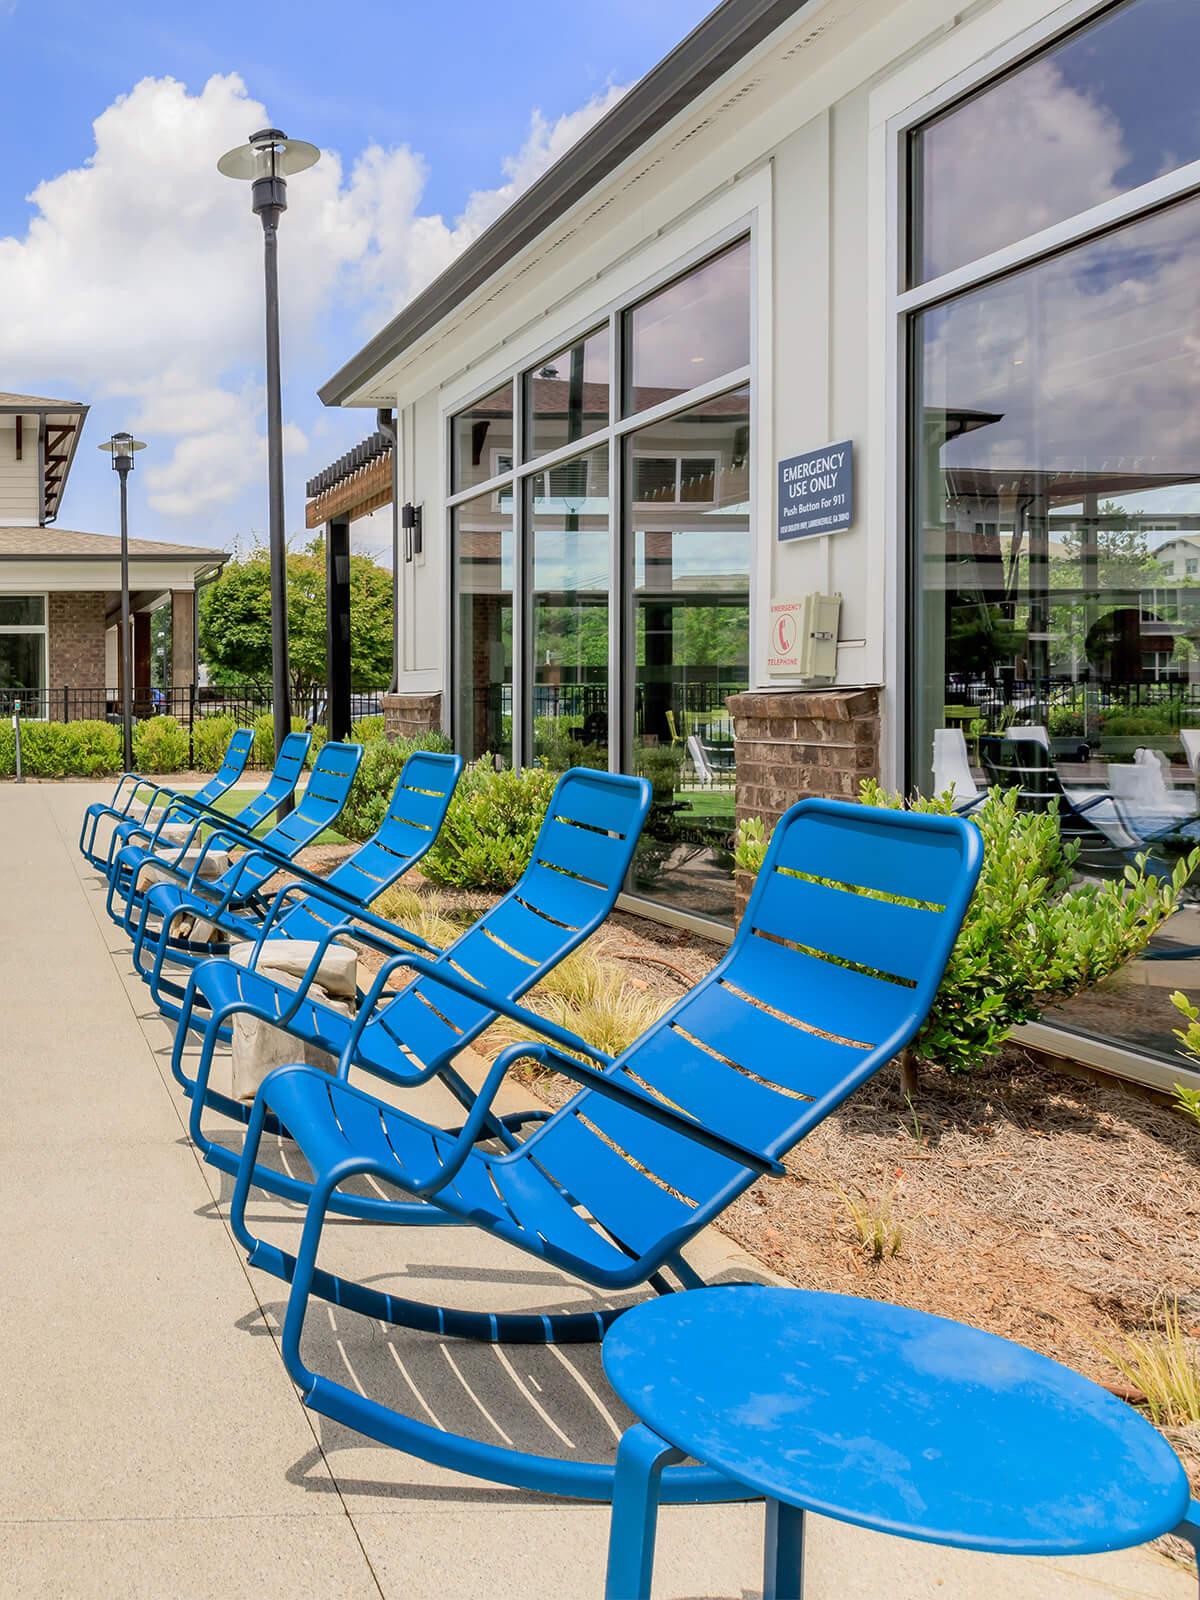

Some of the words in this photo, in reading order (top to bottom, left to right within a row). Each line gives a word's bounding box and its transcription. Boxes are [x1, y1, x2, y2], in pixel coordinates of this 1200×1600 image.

[783, 452, 845, 483] EMERGENCY
[789, 480, 808, 498] USE
[809, 471, 838, 493] ONLY
[783, 504, 798, 517] Push
[798, 502, 820, 514] Button
[820, 497, 832, 508] For
[832, 493, 845, 506] 911
